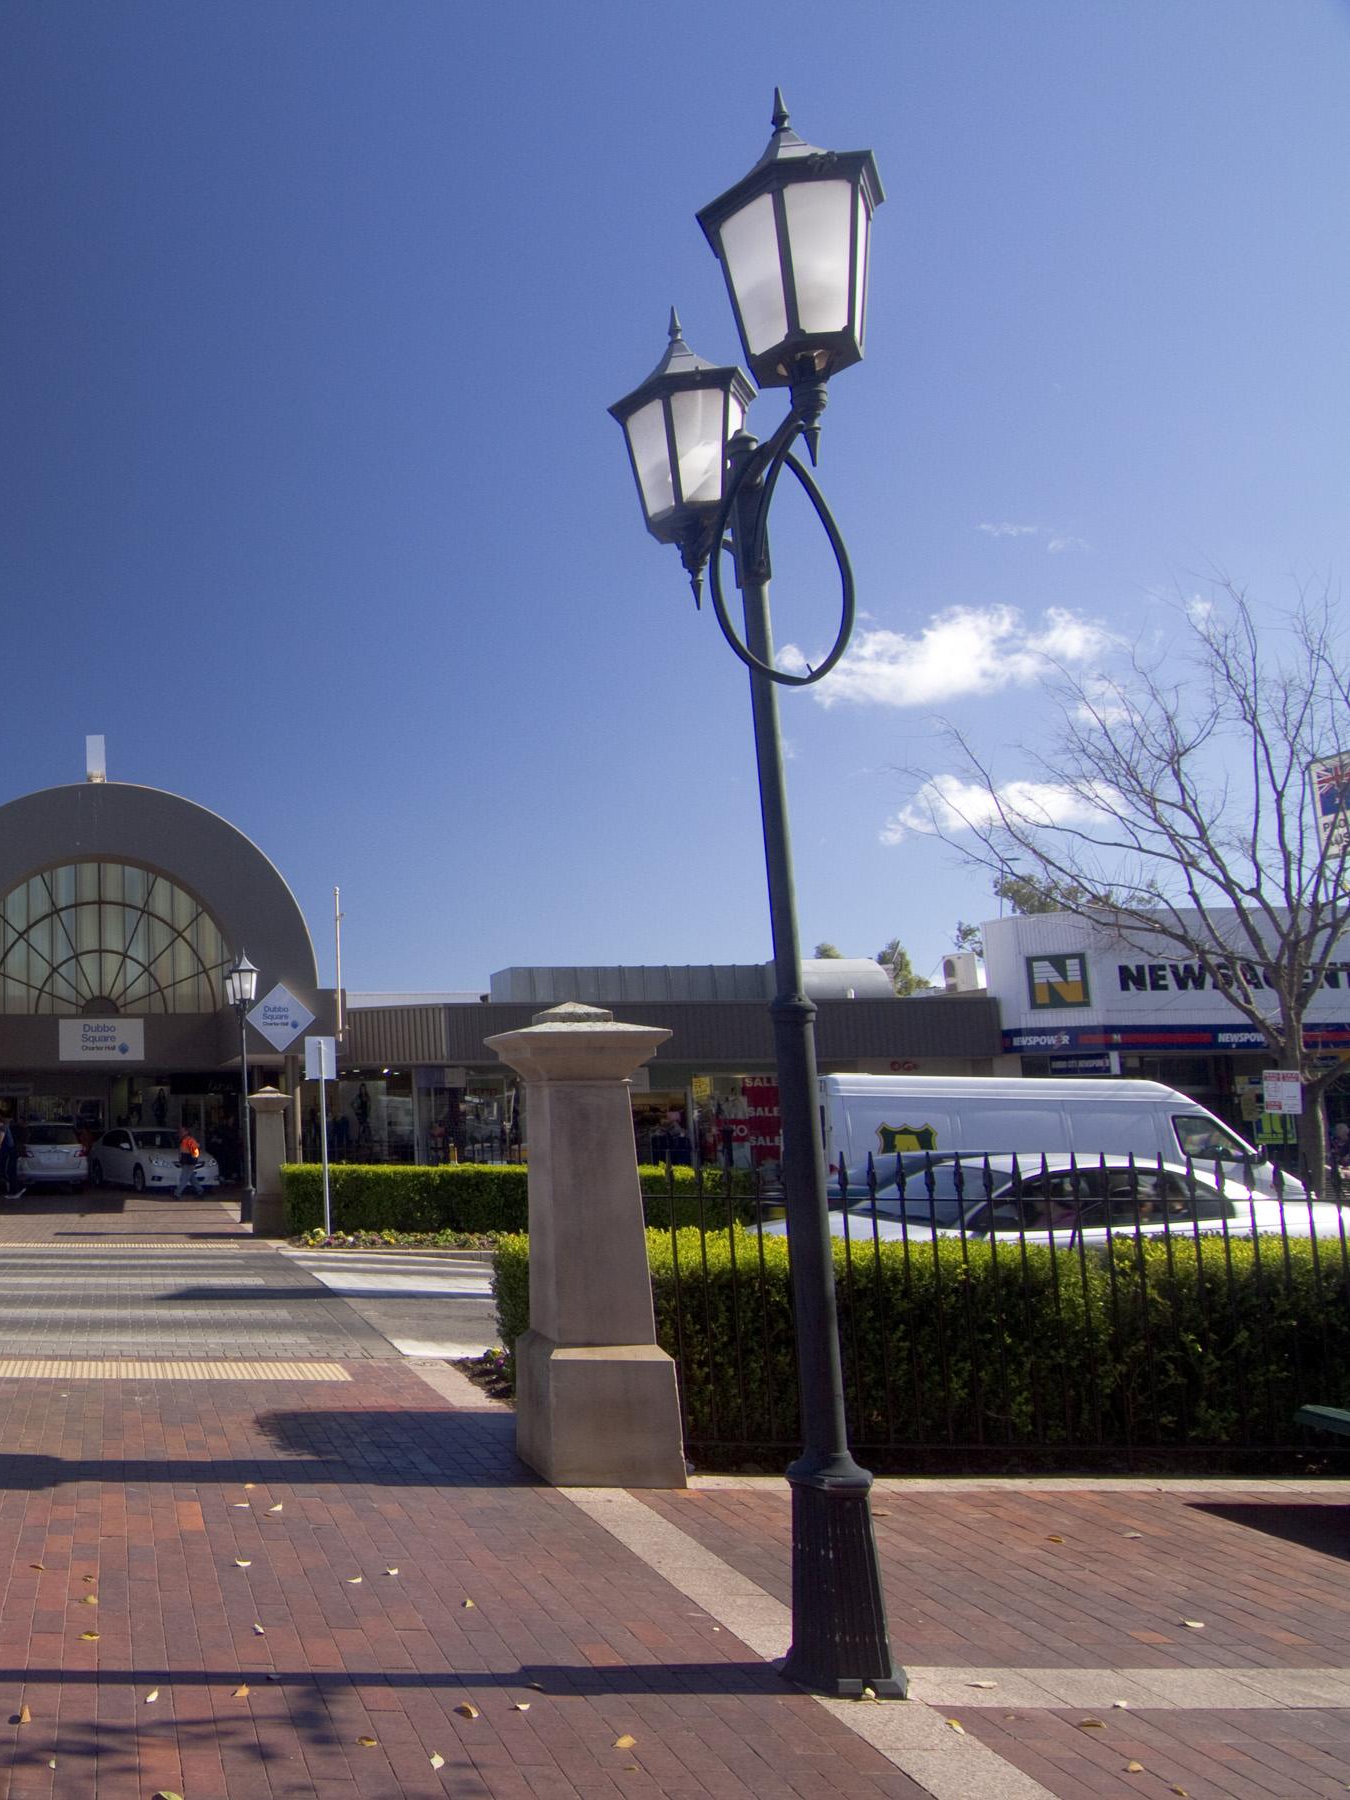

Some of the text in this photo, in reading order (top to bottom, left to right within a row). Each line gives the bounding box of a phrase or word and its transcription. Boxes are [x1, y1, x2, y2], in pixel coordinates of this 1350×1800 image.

[1118, 962, 1350, 991] NEWSAEN
[262, 1013, 289, 1021] Square
[82, 1023, 116, 1033] Dubbo
[81, 1033, 116, 1044] Square
[1218, 1032, 1266, 1043] NEWSPOW
[745, 1077, 778, 1087] SALE
[748, 1107, 780, 1117] SALE
[750, 1136, 782, 1146] SALE
